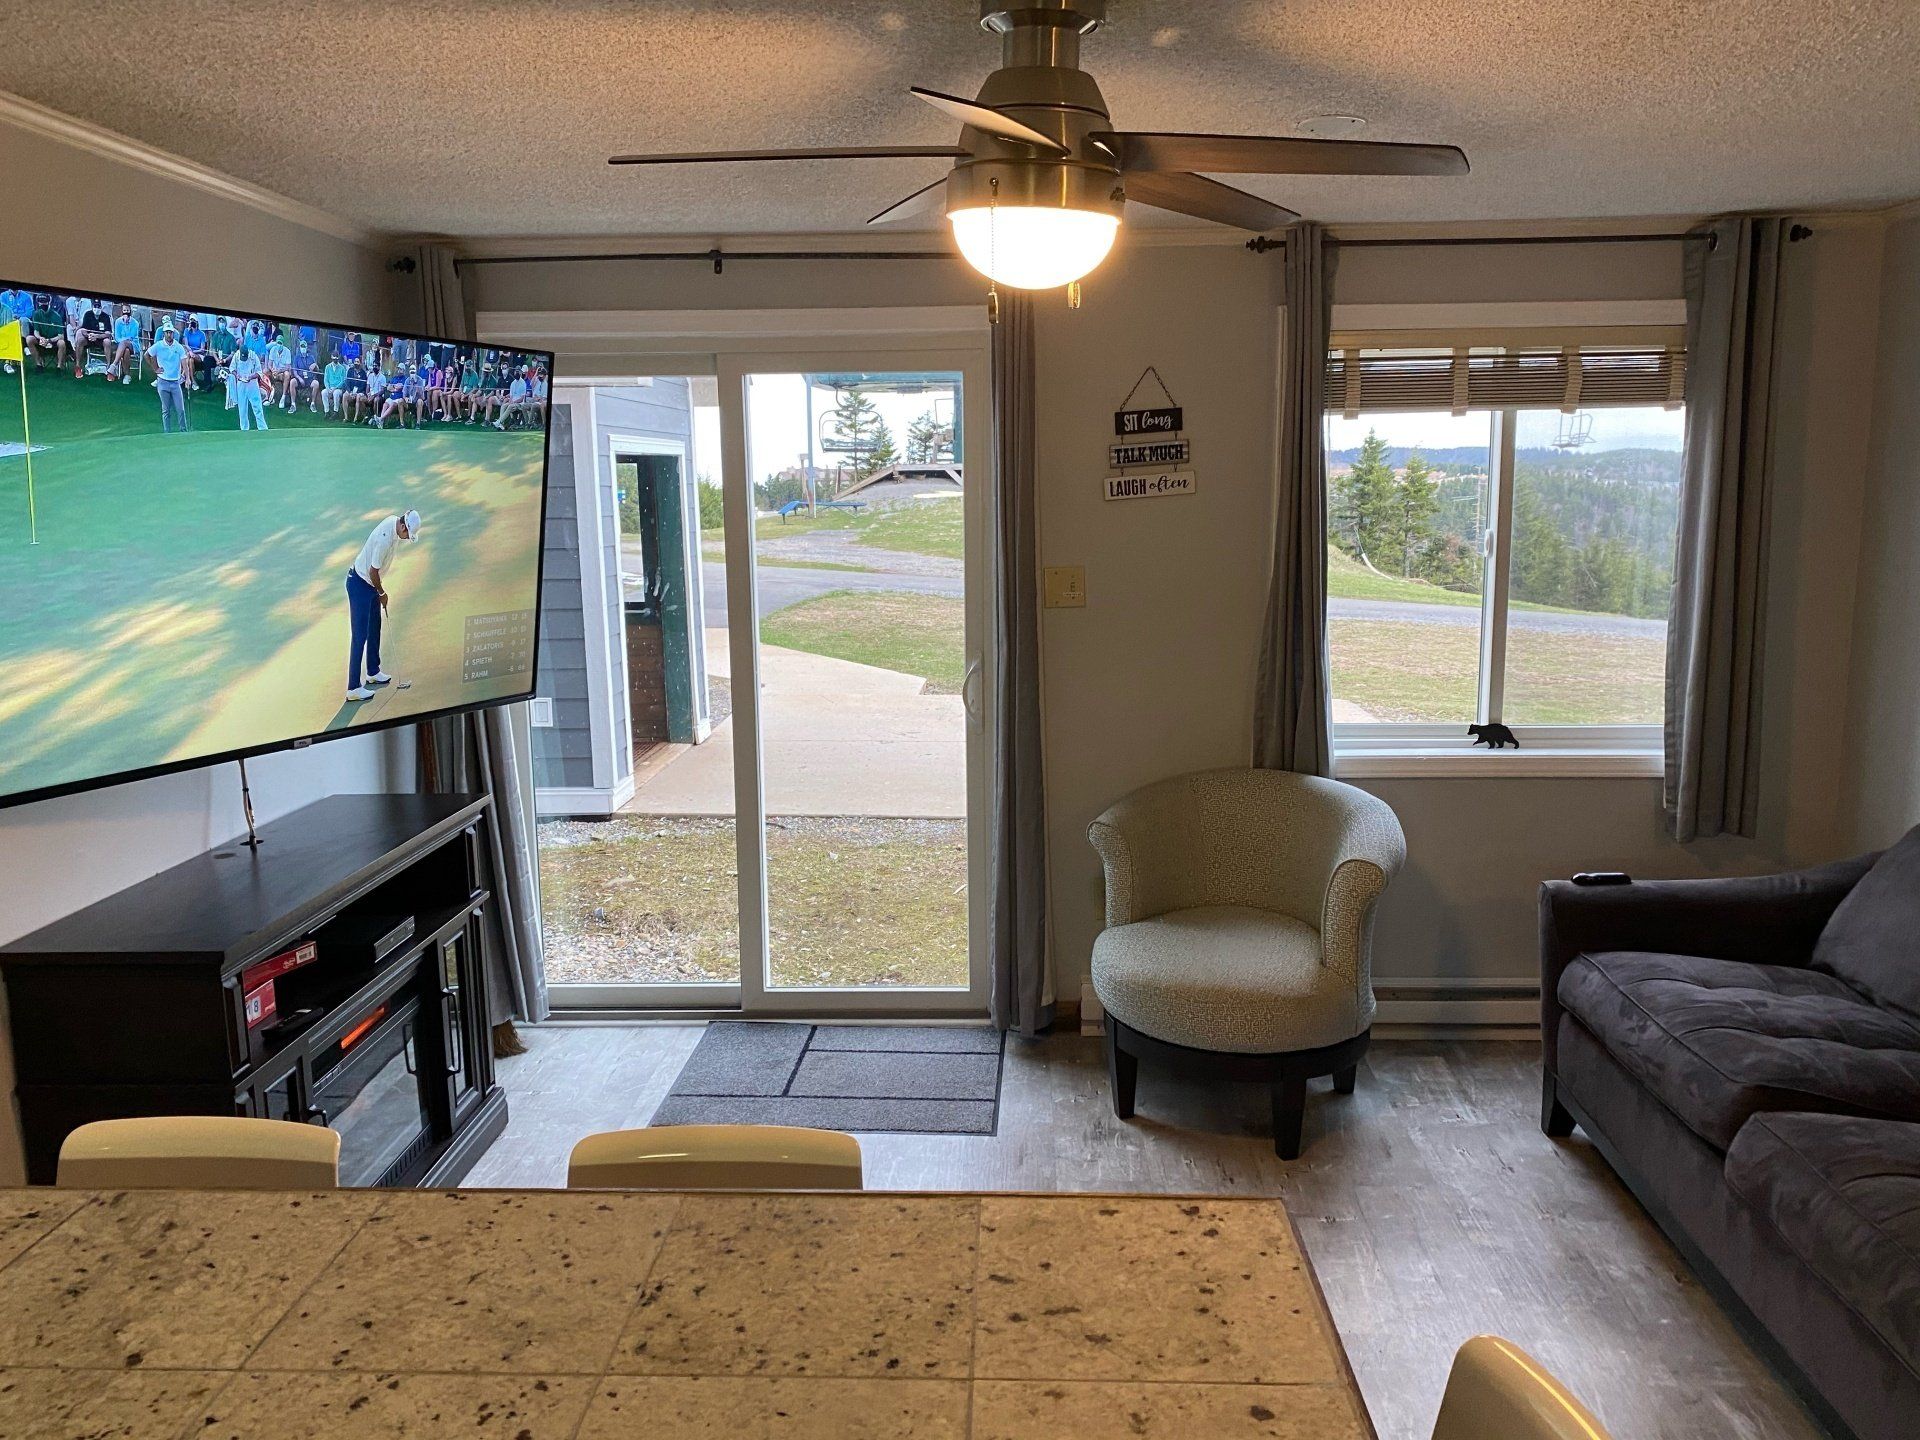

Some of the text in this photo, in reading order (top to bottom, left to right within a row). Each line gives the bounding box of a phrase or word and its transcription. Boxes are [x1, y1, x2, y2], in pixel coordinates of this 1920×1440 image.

[1123, 411, 1173, 431] SIT long
[1114, 444, 1184, 464] TALK MUCH
[1109, 475, 1189, 497] LAUGH often
